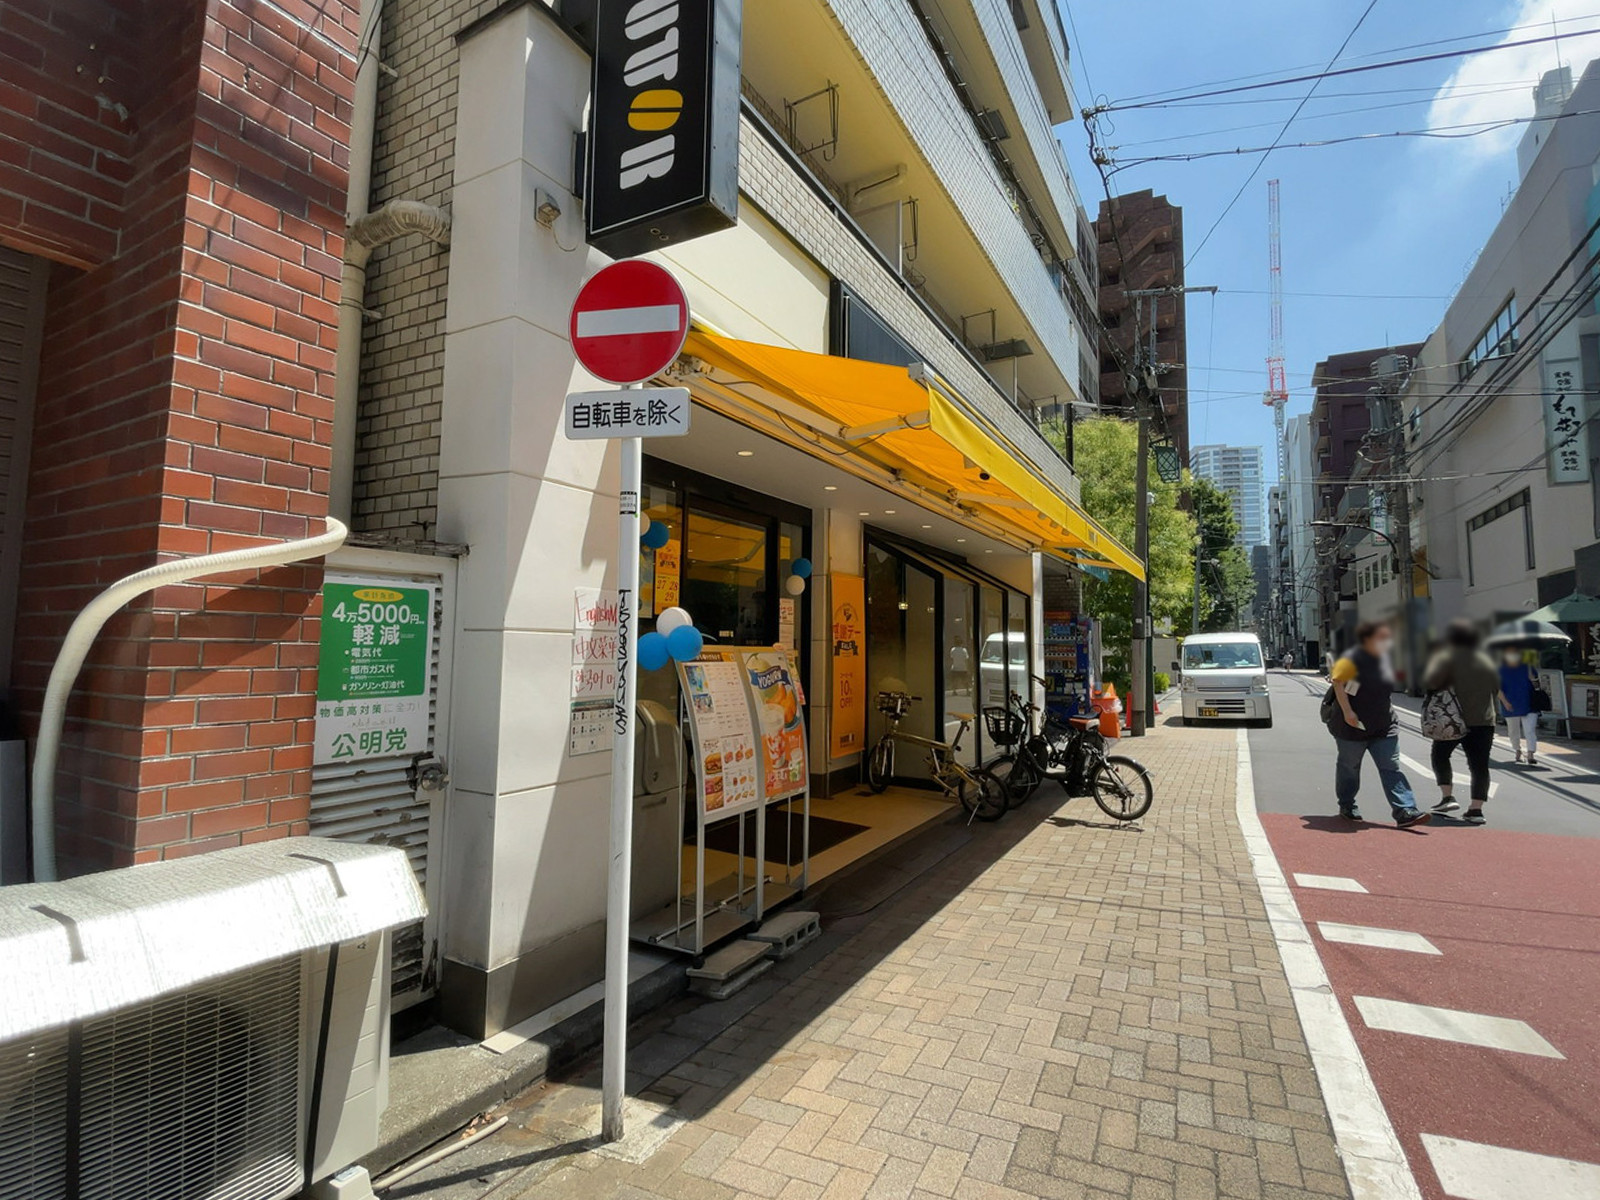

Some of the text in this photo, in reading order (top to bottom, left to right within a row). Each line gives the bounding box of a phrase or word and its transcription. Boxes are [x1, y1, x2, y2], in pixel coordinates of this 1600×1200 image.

[572, 399, 681, 429] 自転車を除く
[332, 602, 420, 625] 4万5000円
[352, 625, 400, 645] 軽減
[351, 647, 382, 658] 電気代
[350, 663, 395, 674] 都市ガス代
[331, 727, 407, 759] 公明党
